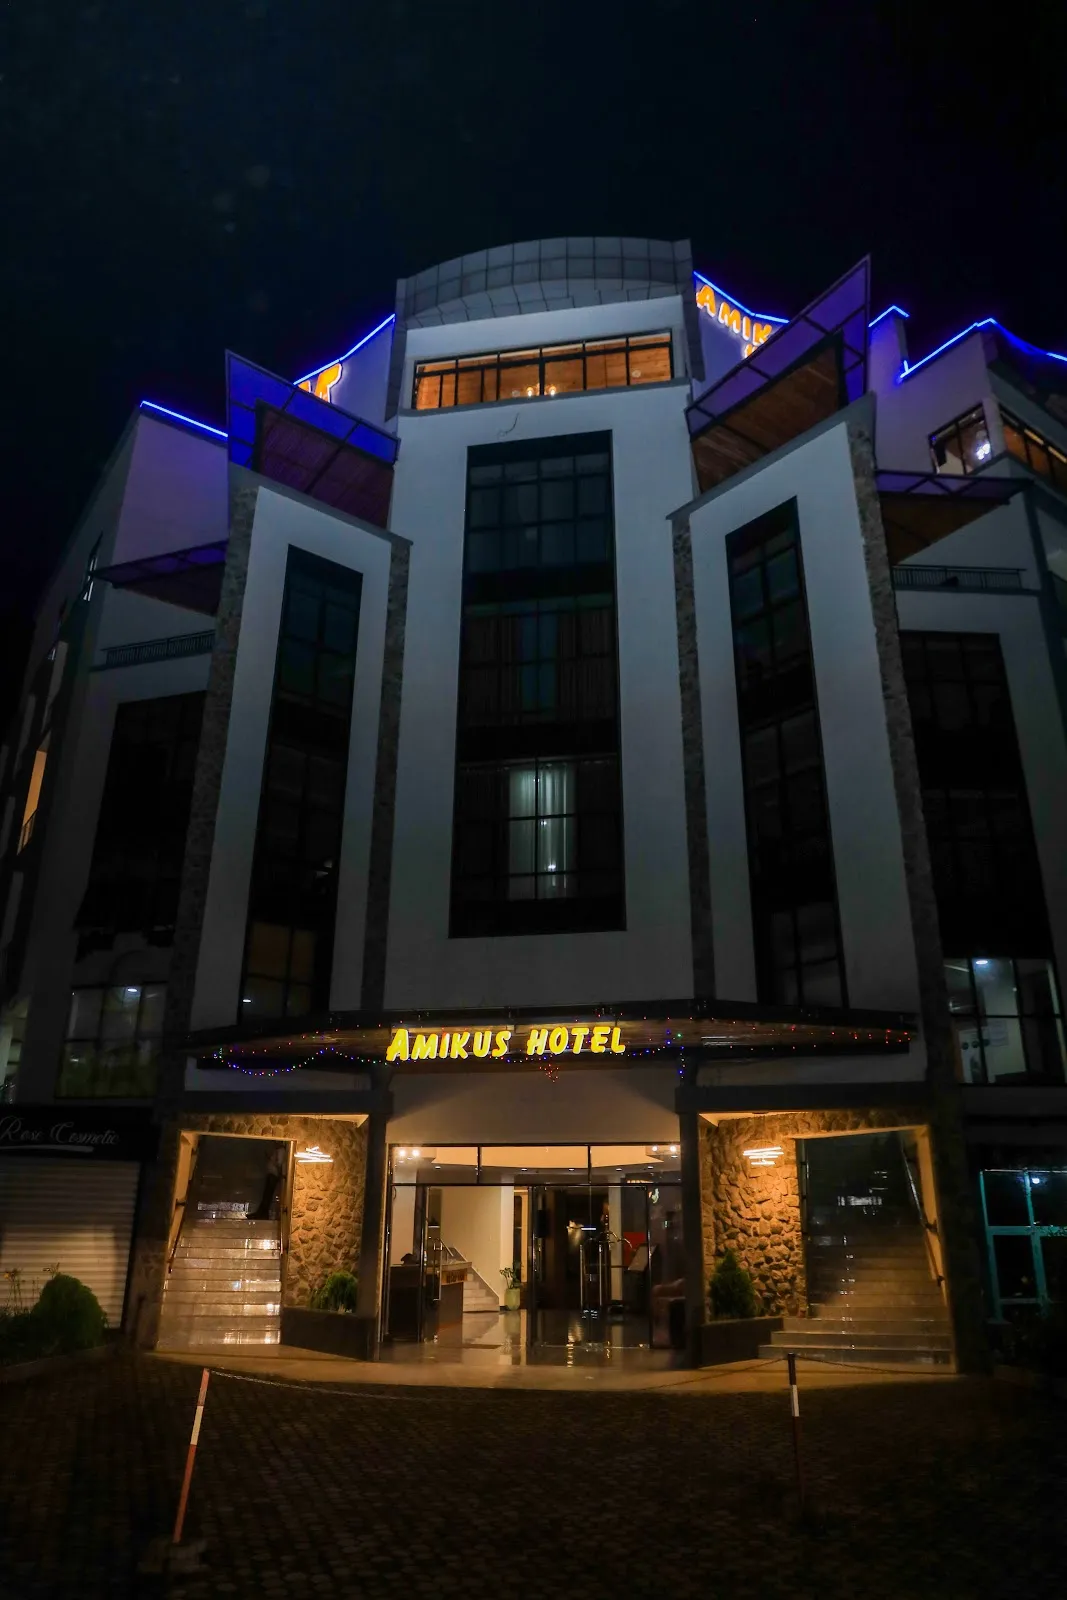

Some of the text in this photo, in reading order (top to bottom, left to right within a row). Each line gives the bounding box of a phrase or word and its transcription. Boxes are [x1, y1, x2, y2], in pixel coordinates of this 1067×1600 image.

[385, 1026, 626, 1062] AMIKUS HOTEL
[49, 1121, 121, 1145] Cosmetic
